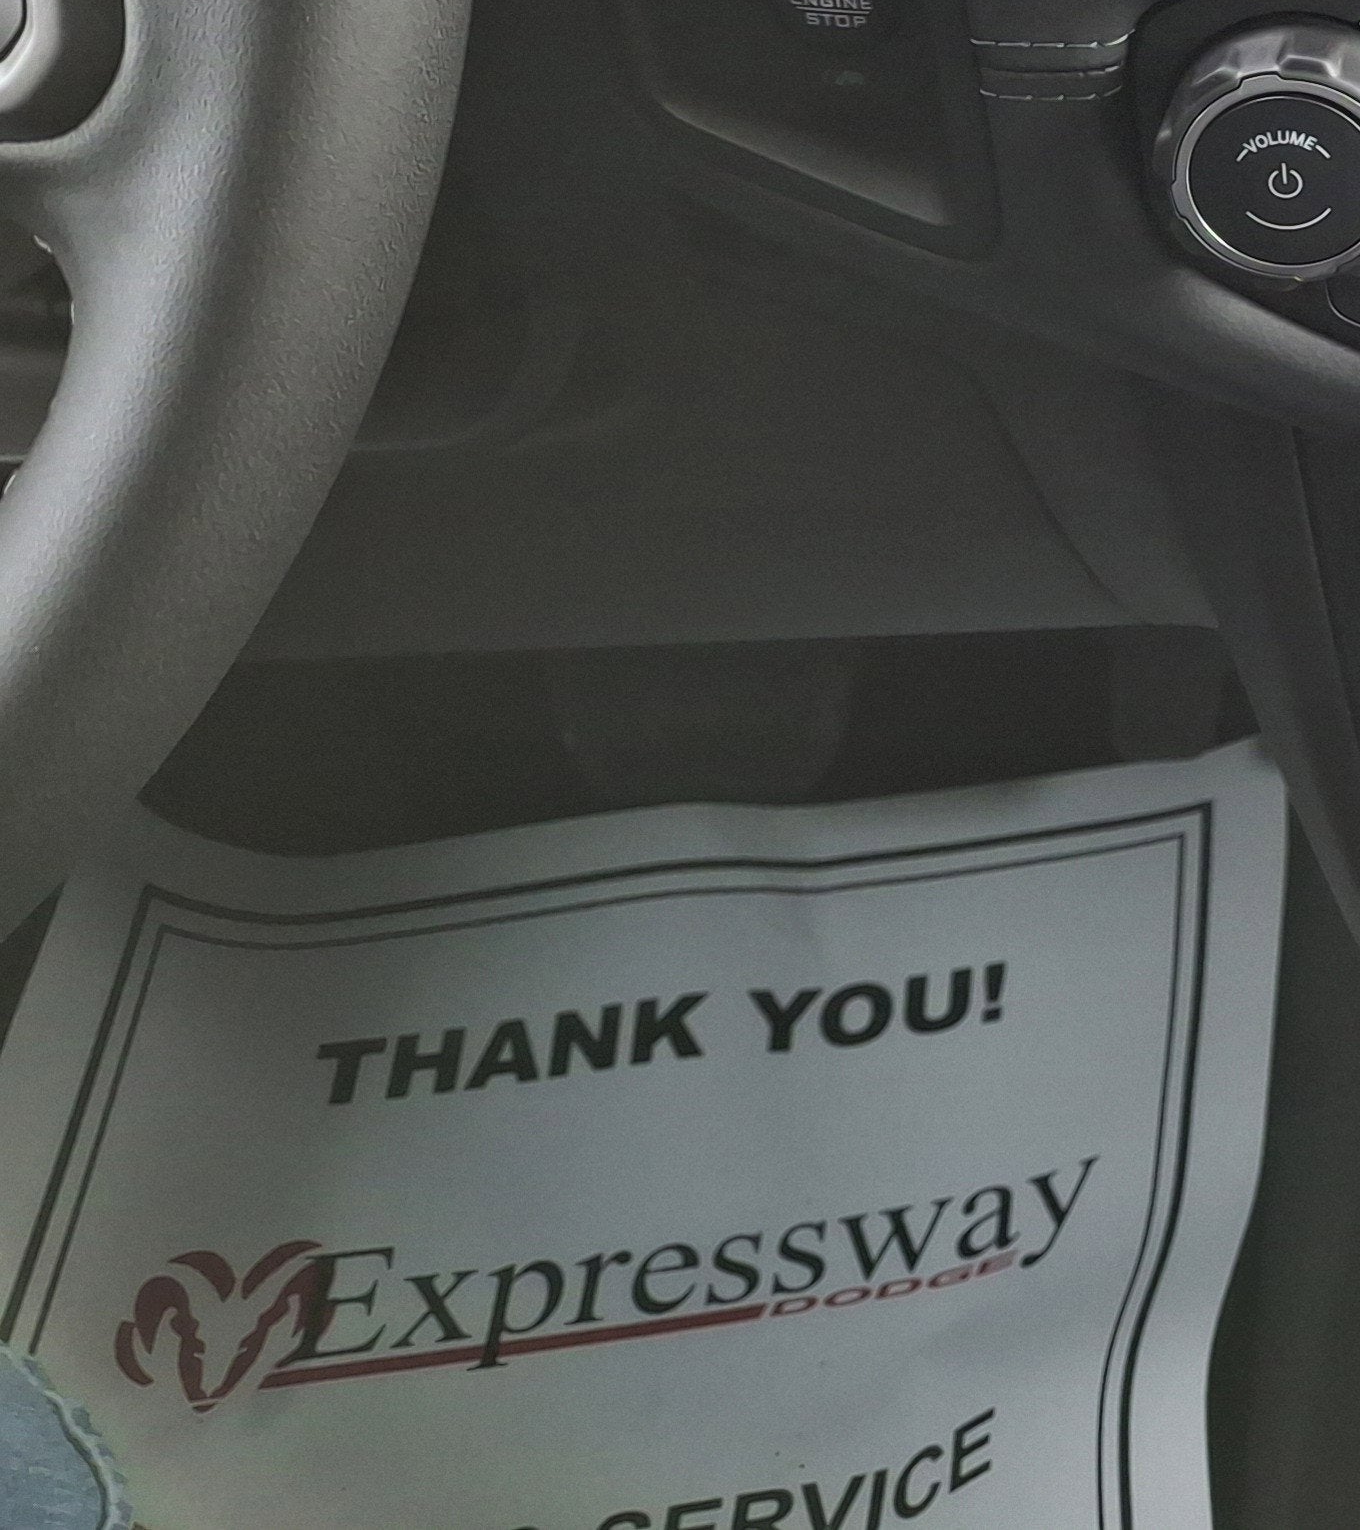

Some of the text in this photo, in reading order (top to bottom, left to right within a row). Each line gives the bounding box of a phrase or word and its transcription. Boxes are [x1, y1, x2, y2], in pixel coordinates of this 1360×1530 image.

[806, 12, 867, 28] STOP
[1243, 130, 1318, 157] VOLUME
[317, 962, 1009, 1106] THANK YOU!
[270, 1155, 1102, 1372] Expressway
[768, 1252, 1024, 1320] DODGE
